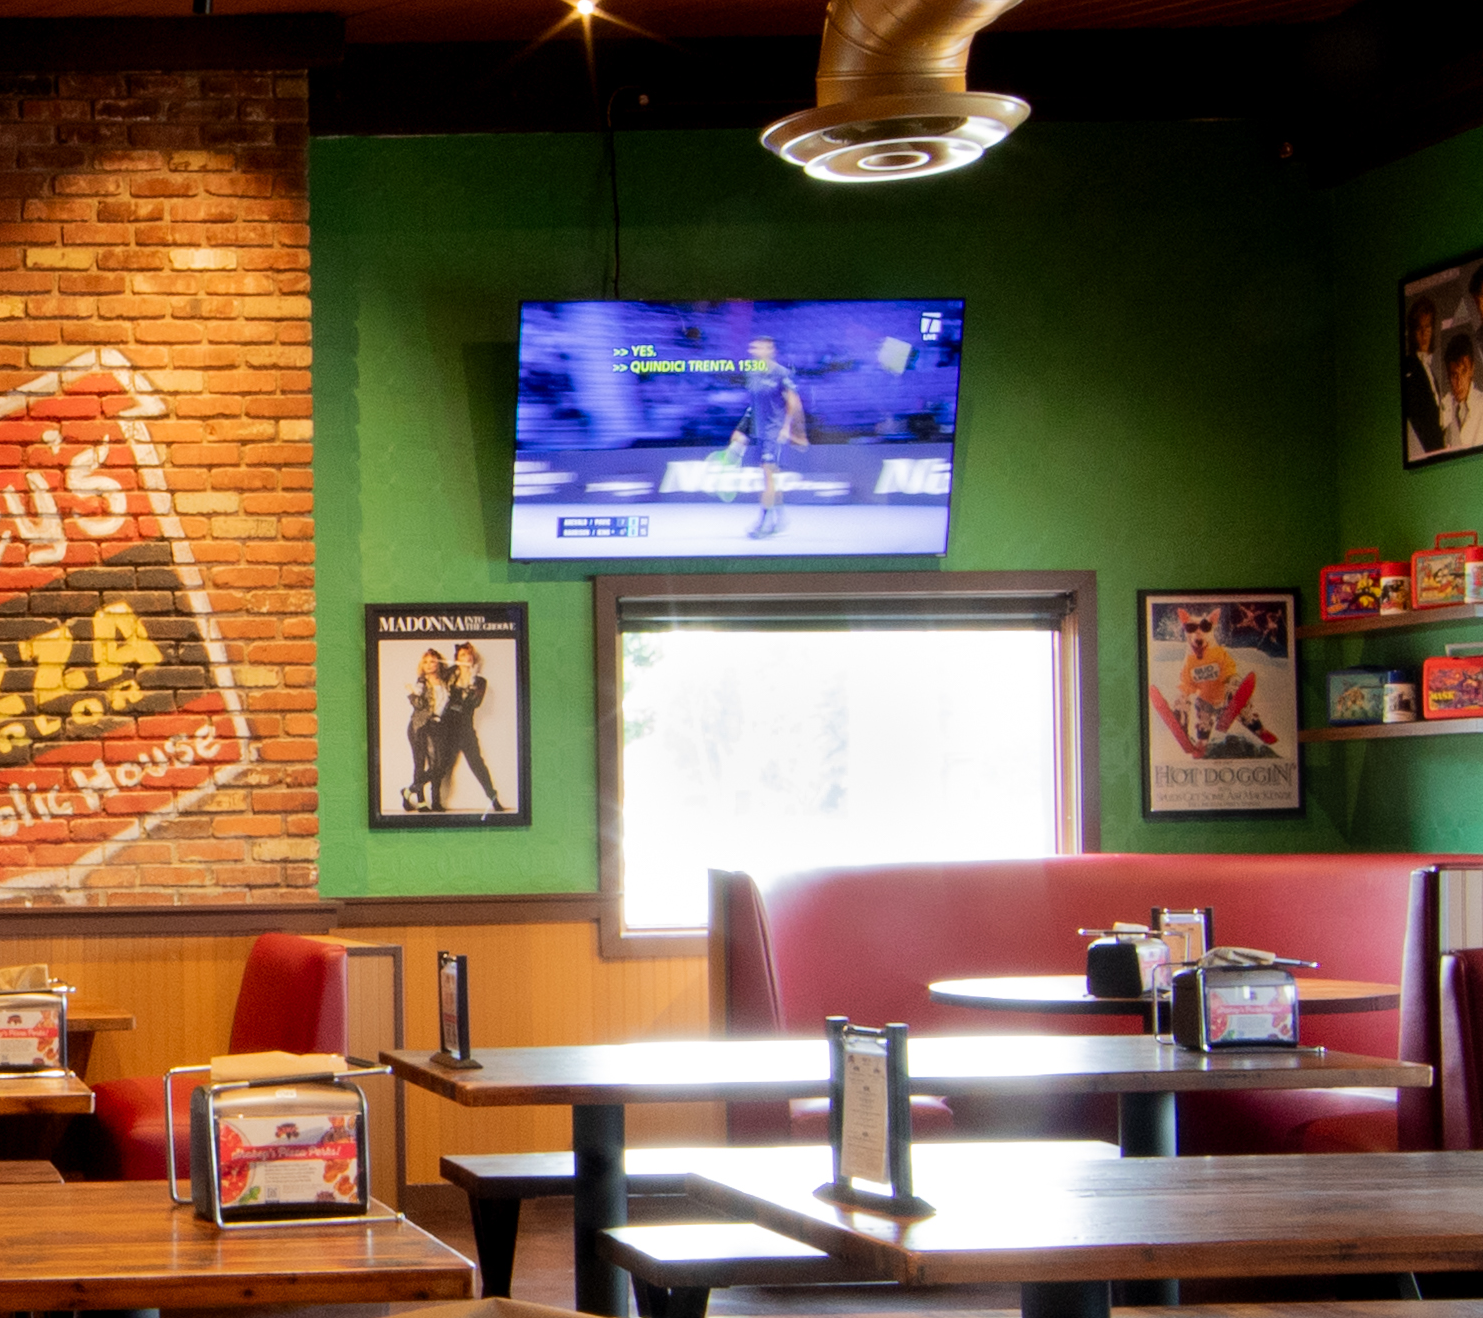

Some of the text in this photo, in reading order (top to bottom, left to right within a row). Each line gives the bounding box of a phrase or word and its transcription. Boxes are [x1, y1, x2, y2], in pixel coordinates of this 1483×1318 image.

[631, 344, 658, 358] YES.
[630, 359, 768, 373] QUINDICI TRENTA 1530.
[378, 615, 486, 632] MADONNA INTO
[482, 622, 517, 631] GROOVE
[71, 723, 222, 812] House
[1154, 762, 1297, 788] HOT DOGGIN'
